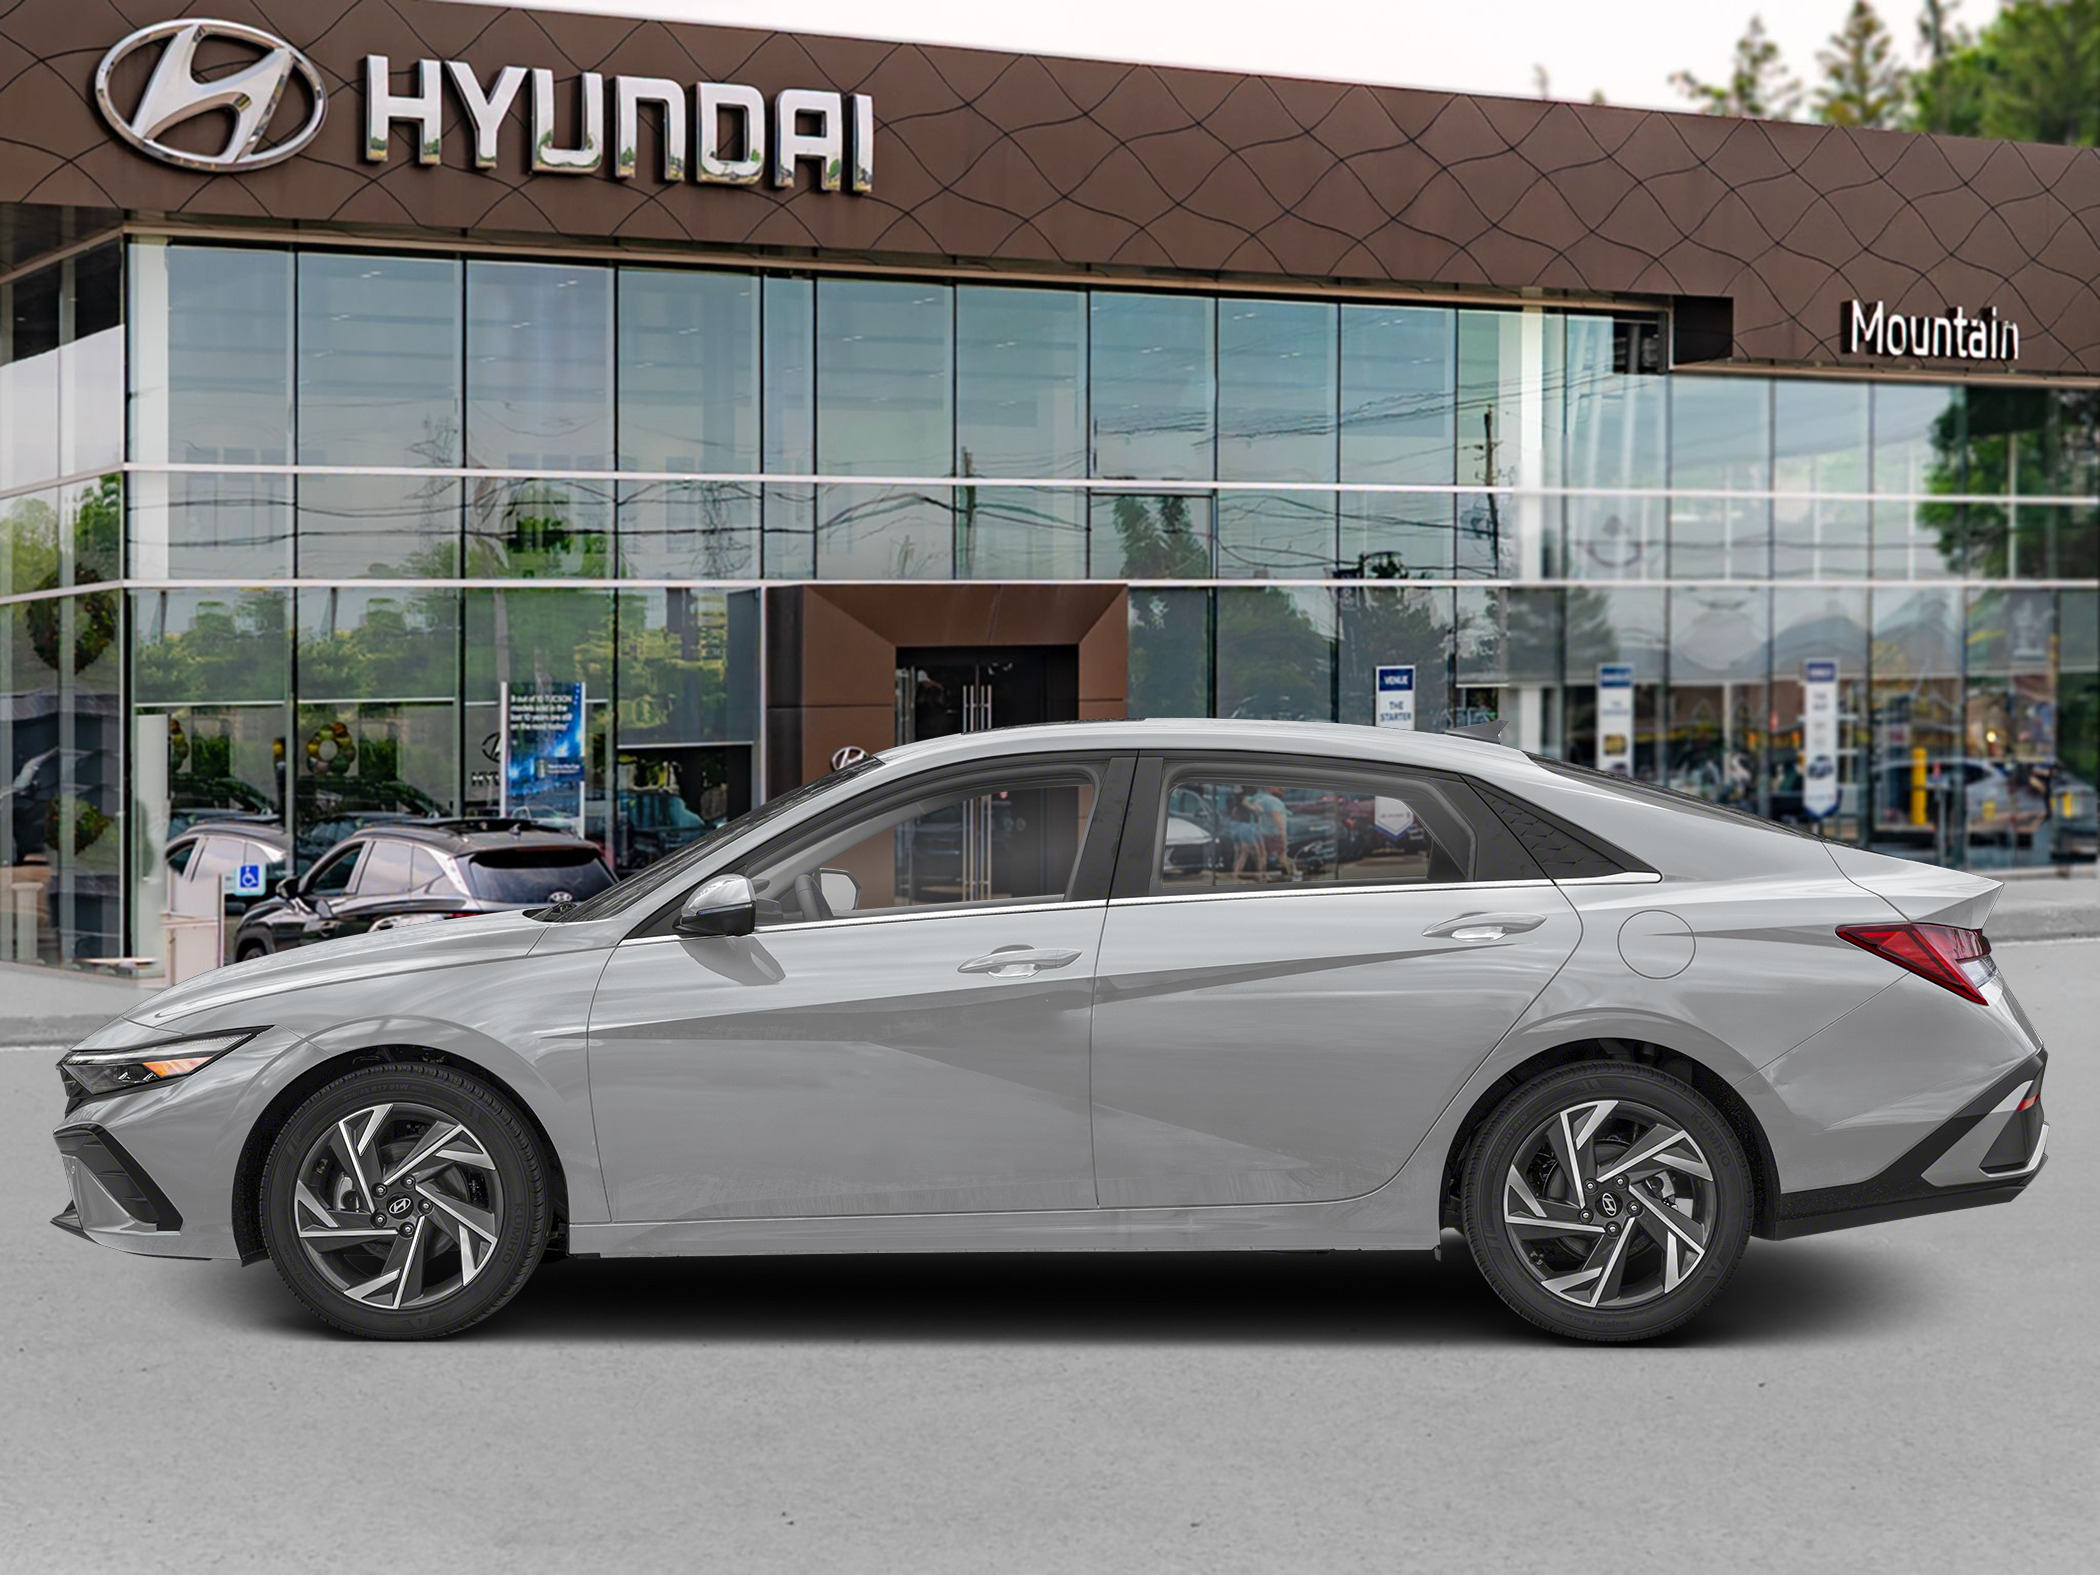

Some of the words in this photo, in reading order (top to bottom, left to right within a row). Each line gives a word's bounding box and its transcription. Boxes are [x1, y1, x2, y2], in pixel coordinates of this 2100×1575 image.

[365, 54, 874, 193] HYUNDAI
[1851, 299, 2019, 361] Mountain
[1383, 675, 1409, 686] VENUE
[1380, 712, 1412, 722] STARTER
[1389, 701, 1404, 711] THE
[502, 1201, 523, 1264] KUMHO
